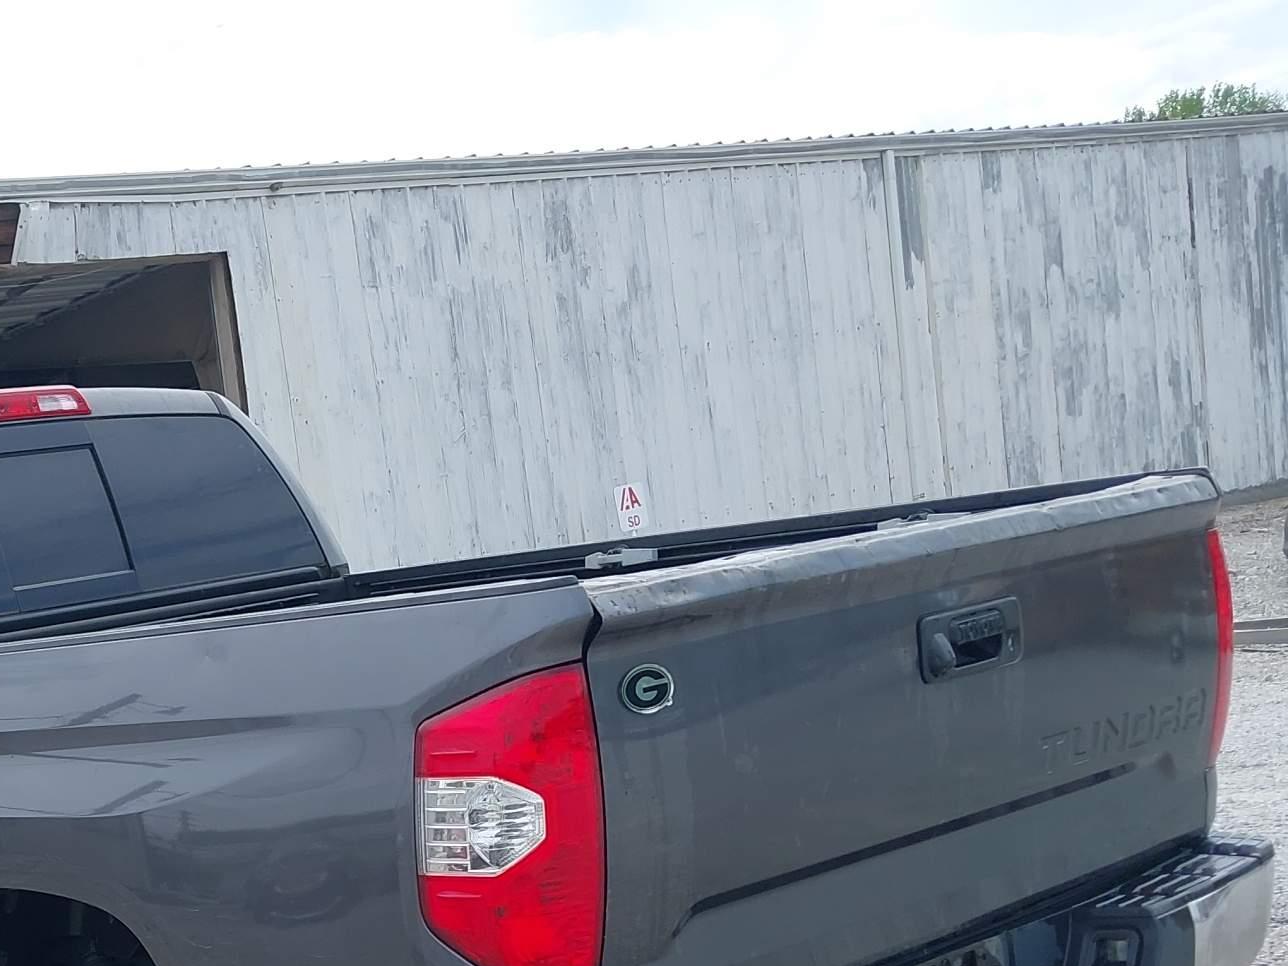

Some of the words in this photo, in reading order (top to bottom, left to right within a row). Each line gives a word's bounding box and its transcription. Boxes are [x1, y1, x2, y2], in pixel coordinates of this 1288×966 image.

[627, 514, 641, 528] SD
[624, 667, 671, 709] G
[1040, 687, 1209, 775] TUNDRA
